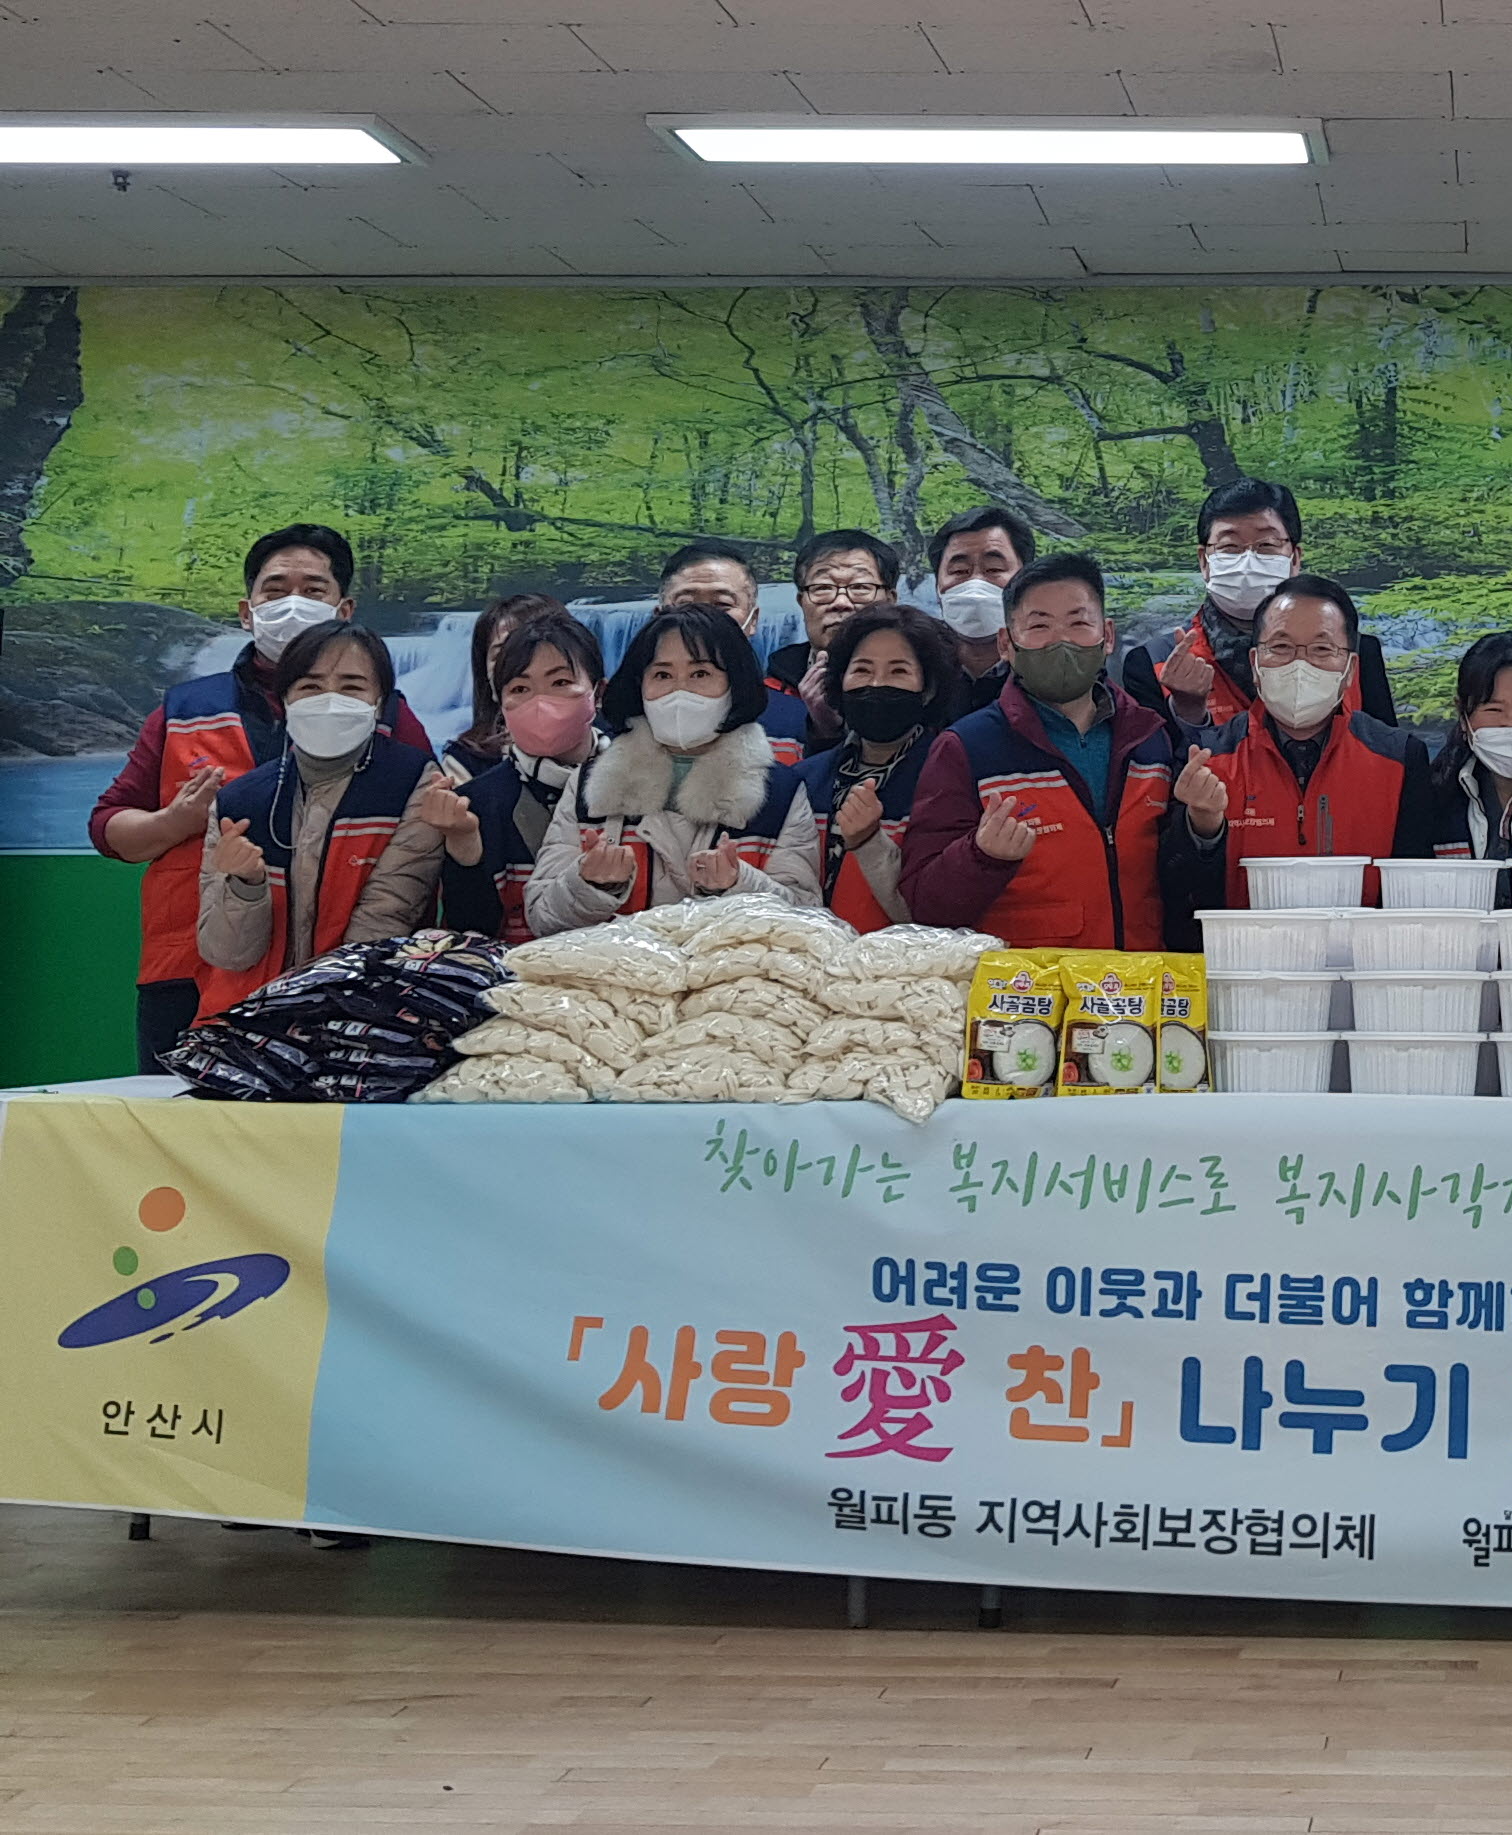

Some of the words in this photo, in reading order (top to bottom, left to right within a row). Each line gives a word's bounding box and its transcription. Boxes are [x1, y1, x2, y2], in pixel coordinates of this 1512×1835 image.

[988, 994, 1053, 1016] 사골곰탕
[1079, 996, 1143, 1016] 사골곰탕
[706, 1119, 912, 1204] 찾아가는
[948, 1141, 1237, 1217] 복지서비스로
[872, 1256, 1022, 1313] 어려운
[1045, 1265, 1203, 1321] 이웃과
[1224, 1273, 1379, 1328] 더불어
[102, 1400, 225, 1445] 안산시
[825, 1313, 966, 1463] 愛
[1180, 1356, 1470, 1461] 나누기
[826, 1487, 957, 1540] 월피동
[975, 1496, 1377, 1561] 지역사회보장협의체
